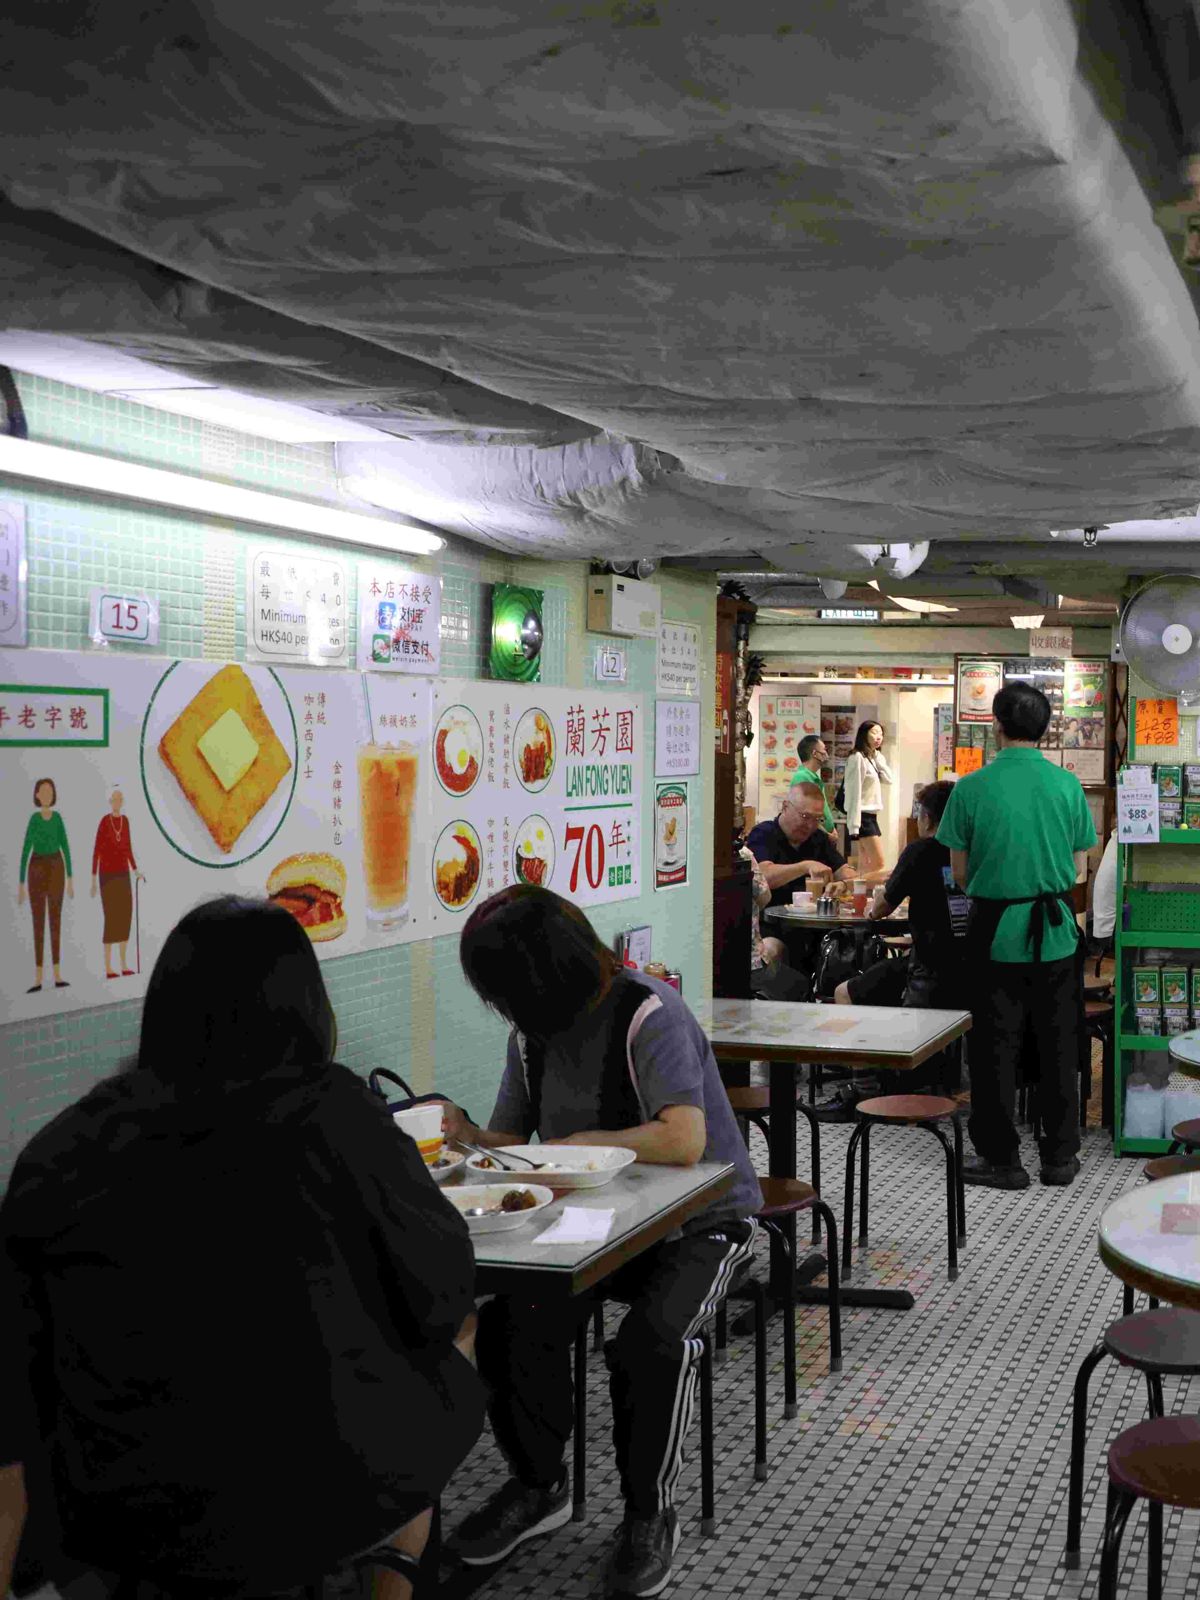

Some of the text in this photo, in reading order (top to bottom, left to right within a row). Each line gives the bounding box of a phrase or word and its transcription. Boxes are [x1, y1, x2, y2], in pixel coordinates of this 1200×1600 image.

[369, 578, 432, 604] 本店不接受
[111, 603, 139, 631] 15
[261, 608, 307, 624] Minimum
[261, 630, 293, 645] HK$40
[605, 657, 617, 673] 12
[565, 704, 633, 757] 蘭芳園
[1144, 732, 1175, 744] $88
[566, 764, 632, 797] LAN FONG YUEN
[1128, 809, 1147, 819] $88
[564, 820, 626, 893] 70年
